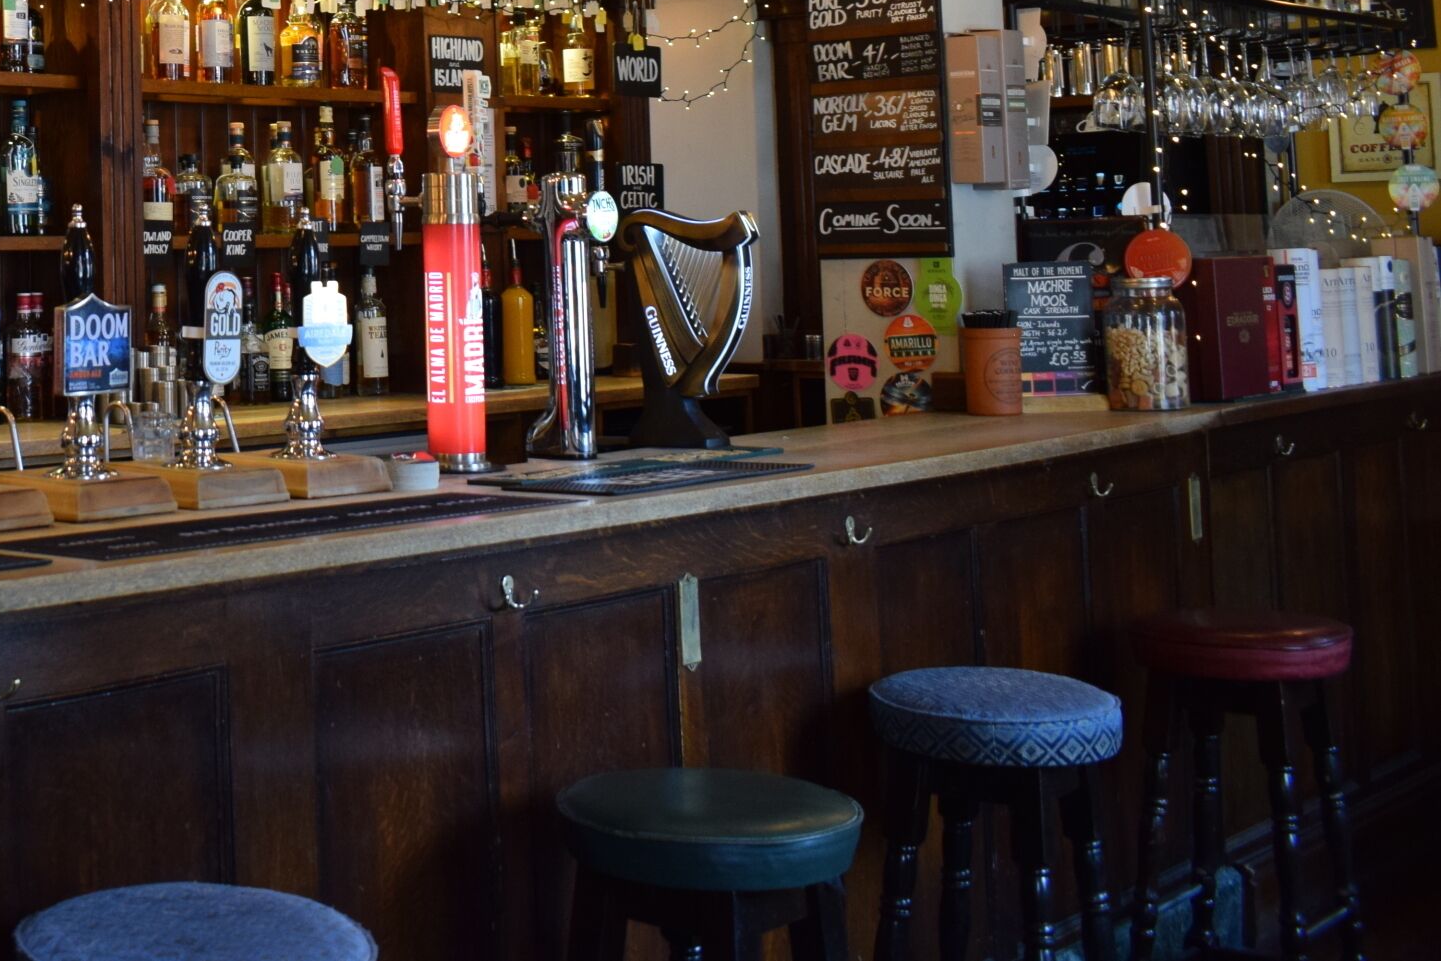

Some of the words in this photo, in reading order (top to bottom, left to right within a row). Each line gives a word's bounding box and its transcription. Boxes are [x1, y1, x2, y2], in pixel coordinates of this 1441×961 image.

[810, 9, 847, 30] GOLD
[856, 8, 883, 20] PURITY
[431, 37, 484, 62] HIGHLAND
[813, 40, 854, 62] DOOM
[617, 55, 658, 83] WORLD
[817, 61, 855, 82] BAR
[813, 92, 869, 115] NORFOLK
[821, 114, 858, 133] GEM
[869, 119, 897, 129] LACONS
[908, 157, 941, 167] AMERICAN
[909, 148, 938, 158] VIBRANT
[814, 153, 871, 175] CASCADE
[910, 168, 926, 176] PALE
[622, 164, 655, 186] IRISH
[873, 170, 904, 180] SALTAIRE
[921, 175, 935, 183] ALE
[620, 190, 658, 210] CELTIC
[223, 229, 252, 242] COOPER
[143, 243, 169, 255] WHISKY
[226, 243, 247, 256] KING
[1013, 267, 1029, 277] MALT
[1031, 267, 1040, 276] OF
[1042, 266, 1055, 276] THE
[1057, 265, 1083, 275] MOMENT
[865, 286, 910, 298] FORCE
[1027, 279, 1073, 294] MACHRIE
[428, 271, 444, 322] MADRID
[737, 267, 752, 330] GUINNESS
[1030, 294, 1068, 307] MOOR
[1023, 307, 1041, 315] CASK
[1045, 306, 1079, 315] STRENGTH
[70, 312, 128, 340] DOOM
[210, 312, 241, 337] GOLD
[266, 331, 289, 342] JAMES
[429, 327, 445, 343] DE
[644, 305, 677, 378] GUINNESS
[890, 337, 932, 349] AMARILLO
[70, 340, 111, 368] BAR
[214, 341, 232, 359] Purity
[430, 348, 446, 384] ALMA
[431, 386, 447, 404] EL
